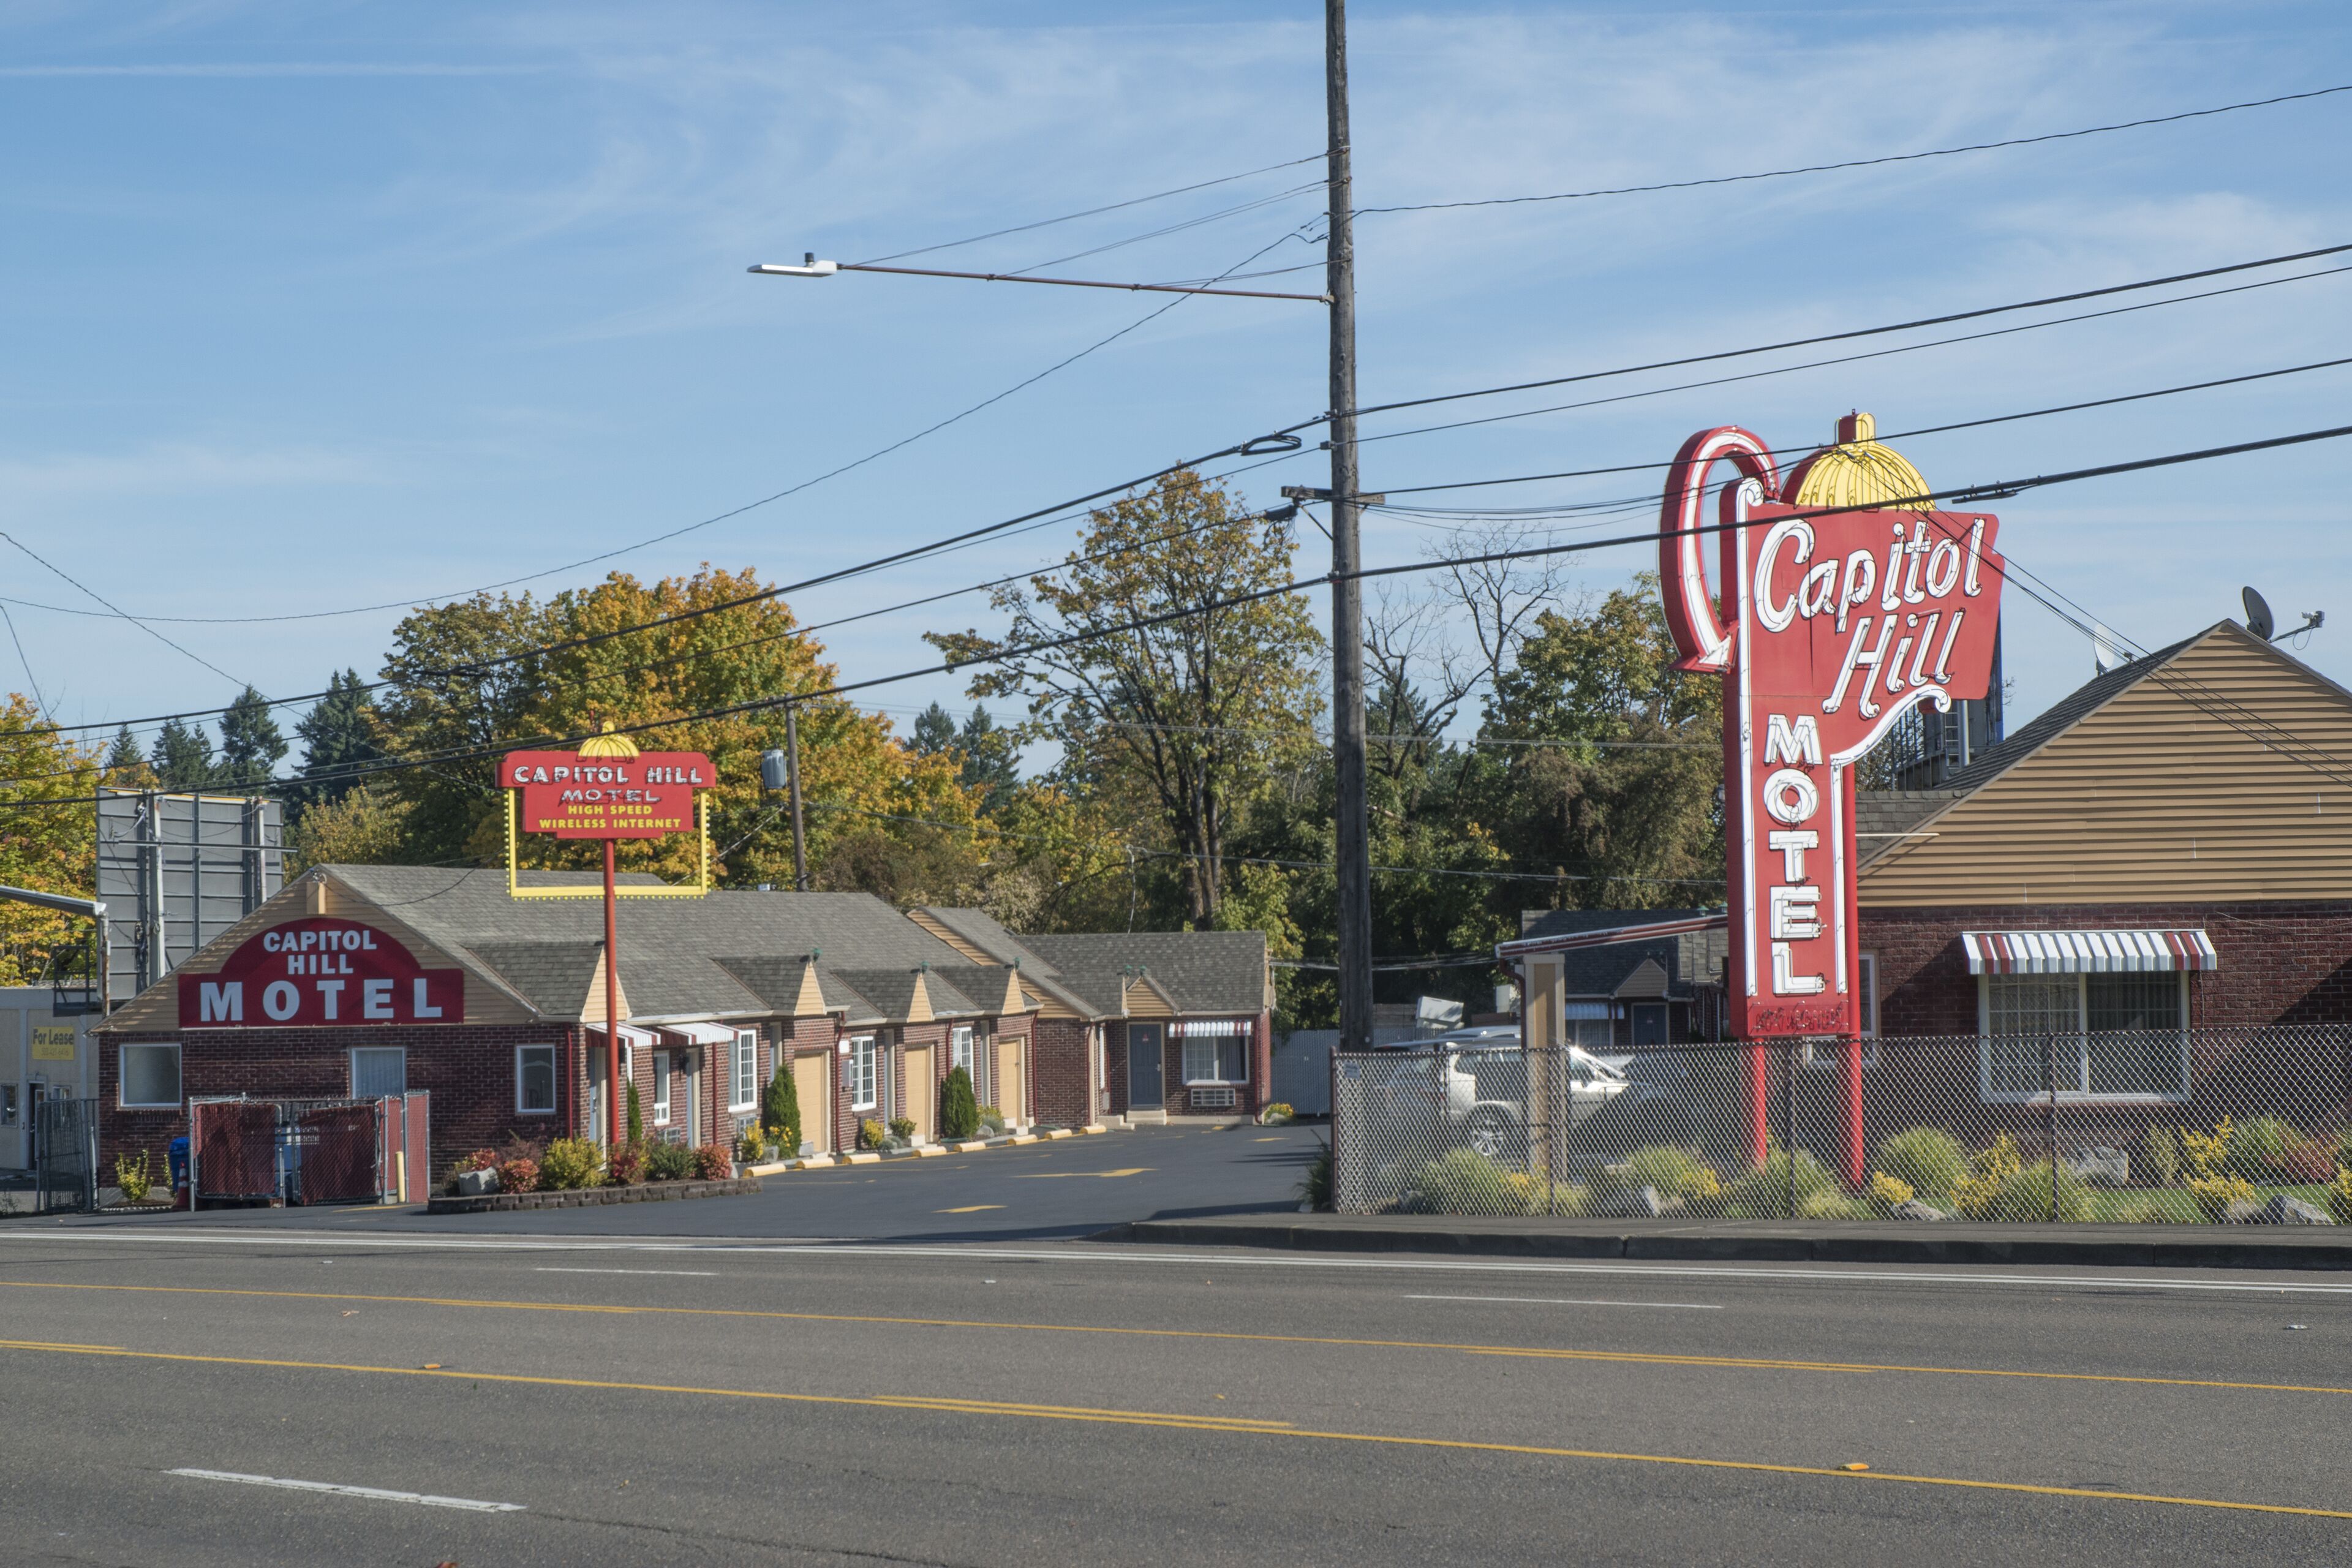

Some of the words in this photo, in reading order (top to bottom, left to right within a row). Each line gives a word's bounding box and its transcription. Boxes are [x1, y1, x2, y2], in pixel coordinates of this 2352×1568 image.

[1754, 517, 1986, 633] Capitol
[1822, 609, 1966, 718] Hill
[514, 766, 629, 783] CAPITOL
[646, 766, 703, 783] HILL
[561, 789, 661, 802] MOTEL
[568, 805, 603, 815] HIGH
[610, 805, 652, 815] SPEED
[539, 819, 606, 828] WIRELESS
[613, 818, 681, 827] INTERNET
[1763, 713, 1825, 995] MOTEL
[263, 930, 377, 952] CAPITOL
[288, 954, 353, 975] HILL
[200, 978, 442, 1022] MOTEL
[33, 1029, 47, 1045] For
[49, 1029, 74, 1045] Lease
